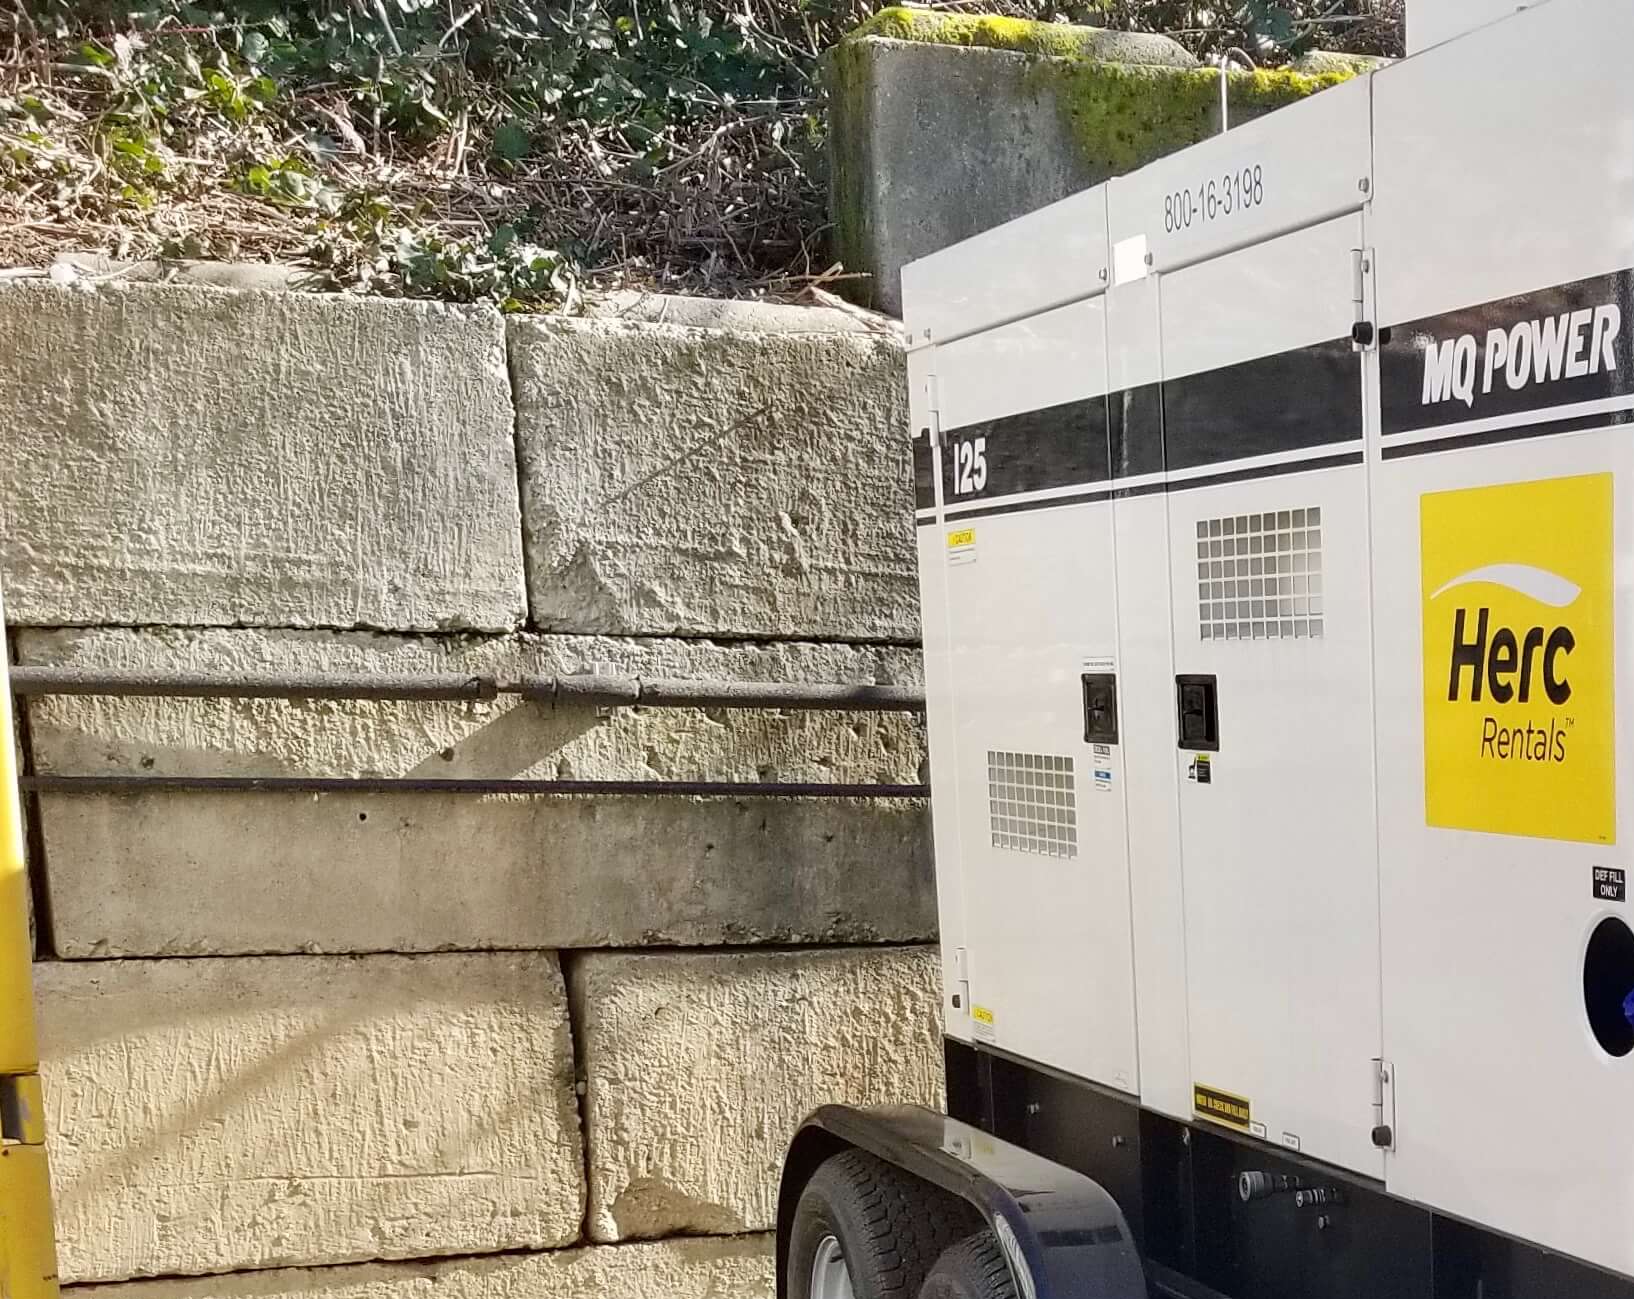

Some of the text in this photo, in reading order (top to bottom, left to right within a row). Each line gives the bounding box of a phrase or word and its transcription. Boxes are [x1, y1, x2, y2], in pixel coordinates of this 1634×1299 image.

[1164, 164, 1264, 233] 800-16-3198
[1422, 303, 1621, 408] MQ POWER
[953, 437, 988, 495] 125
[1447, 607, 1576, 705] Herc
